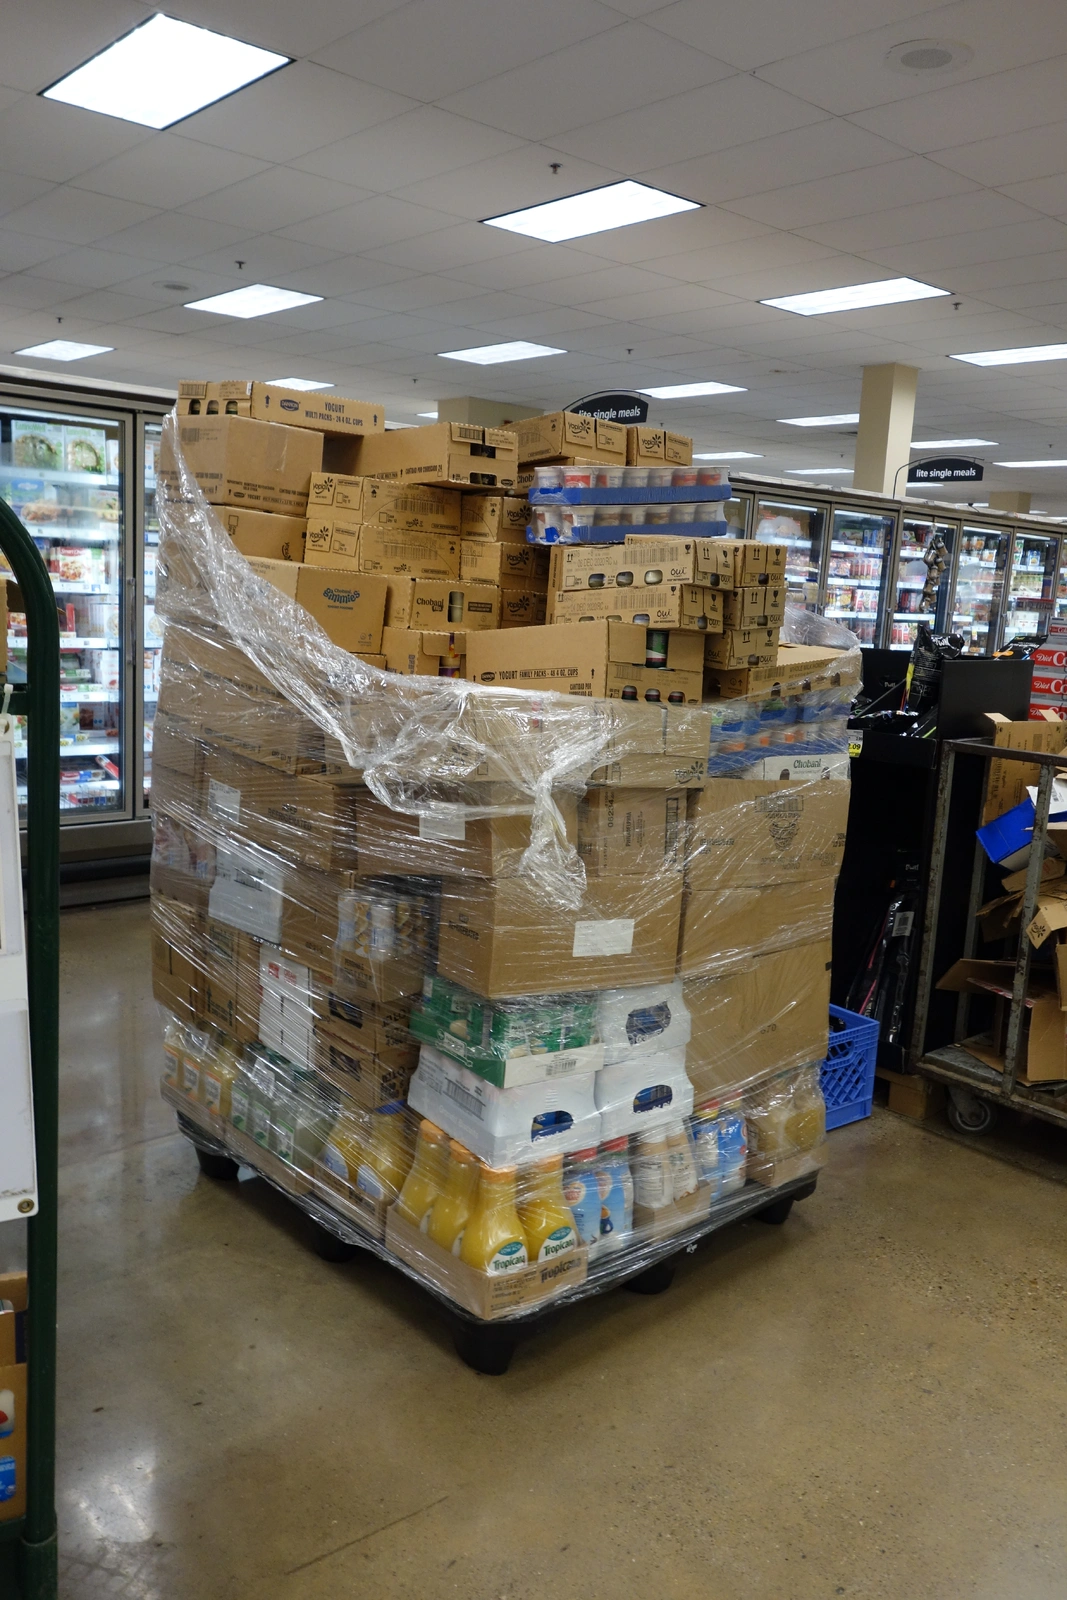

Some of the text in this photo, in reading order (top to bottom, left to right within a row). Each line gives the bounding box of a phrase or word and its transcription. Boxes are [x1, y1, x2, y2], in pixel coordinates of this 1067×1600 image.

[324, 401, 345, 414] YOGURT
[578, 405, 641, 421] lite single meals
[305, 410, 318, 420] MULTI
[318, 412, 332, 422] PACKS
[352, 418, 363, 427] CUPS
[916, 467, 976, 479] lite single meals
[416, 597, 445, 607] Chobani
[1036, 651, 1067, 667] Diet Co
[499, 670, 518, 680] YOGURT
[520, 669, 533, 679] FAMILY
[533, 669, 547, 678] PACKS
[567, 668, 579, 676] CUPS
[584, 682, 592, 690] POR
[1033, 679, 1067, 695] Diet Co
[793, 758, 822, 769] Chobani
[540, 1257, 582, 1284] Tropicana
